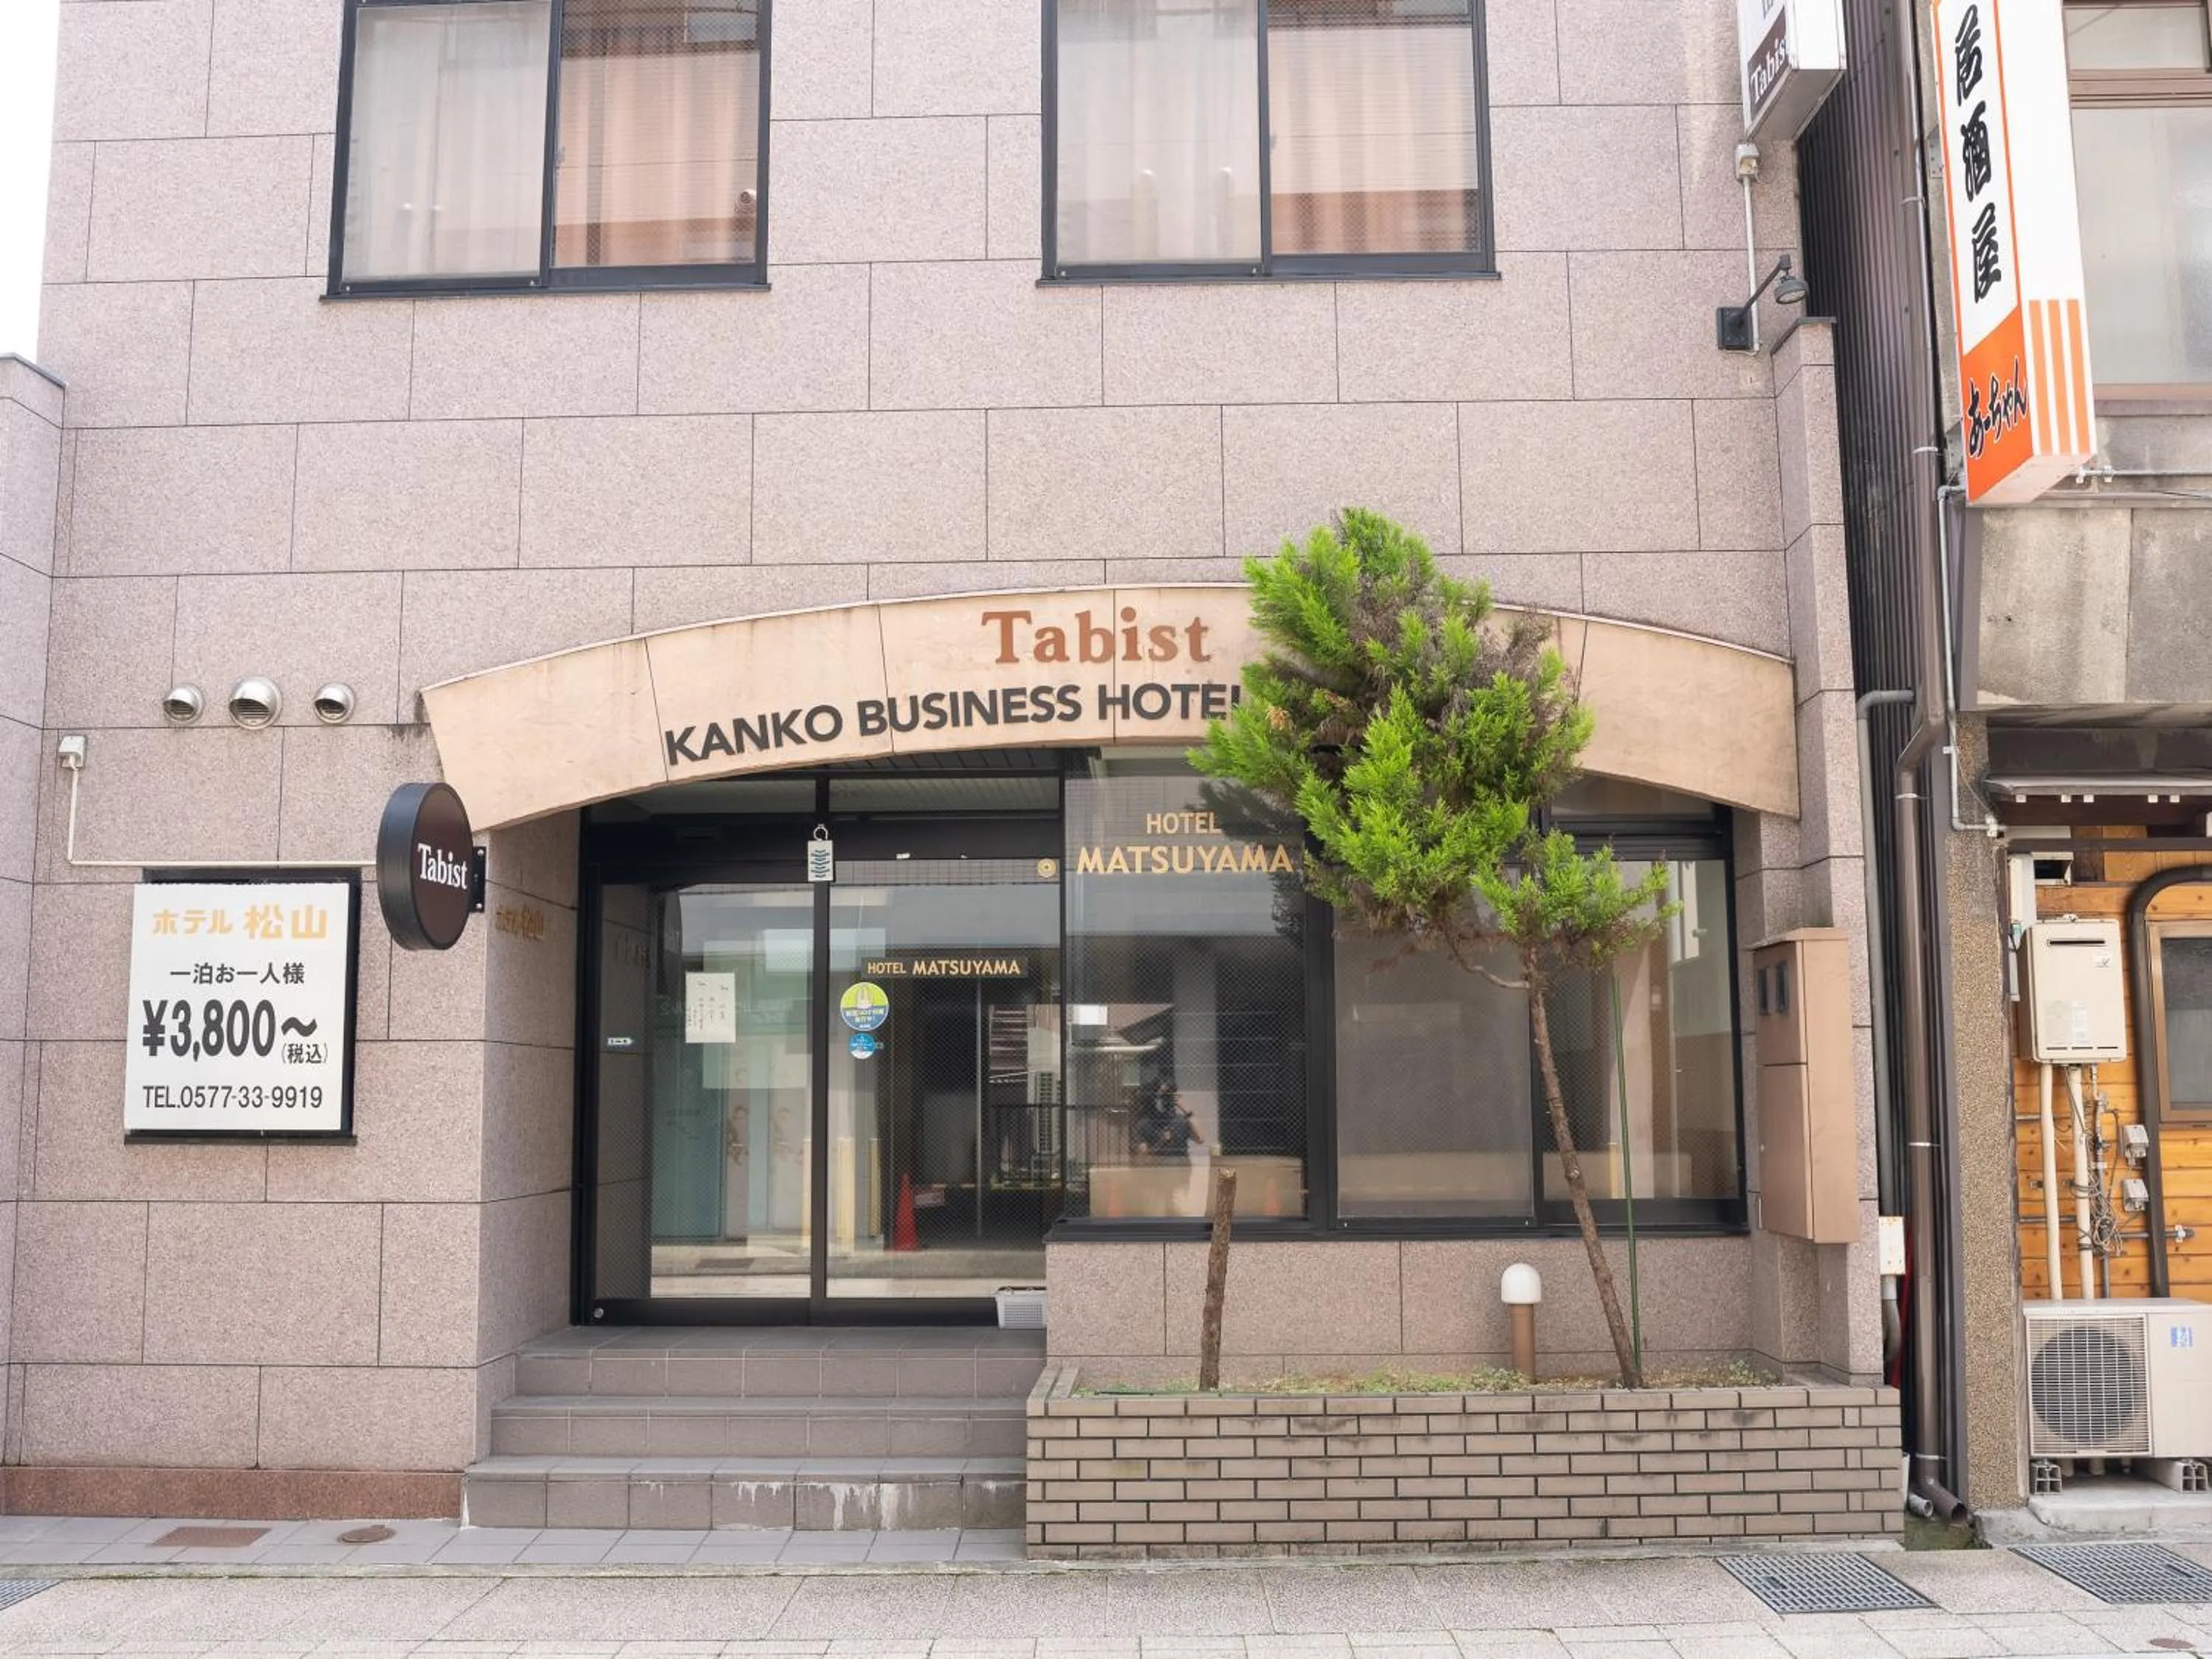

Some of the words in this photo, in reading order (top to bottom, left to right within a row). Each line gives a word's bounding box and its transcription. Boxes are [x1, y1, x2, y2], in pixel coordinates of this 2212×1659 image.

[1750, 37, 1790, 104] Tabis
[1955, 4, 2001, 303] 居酒屋
[981, 606, 1211, 666] Tabist
[666, 703, 843, 766] KANKO
[857, 684, 1082, 737] BUSINESS
[1146, 813, 1222, 835] HOTEL
[417, 843, 468, 890] Tabist
[1077, 844, 1294, 874] MATSUYAMA
[170, 962, 305, 984] 一泊お一人様
[868, 962, 906, 974] HOTEL
[912, 960, 1020, 975] MATSUYAMA
